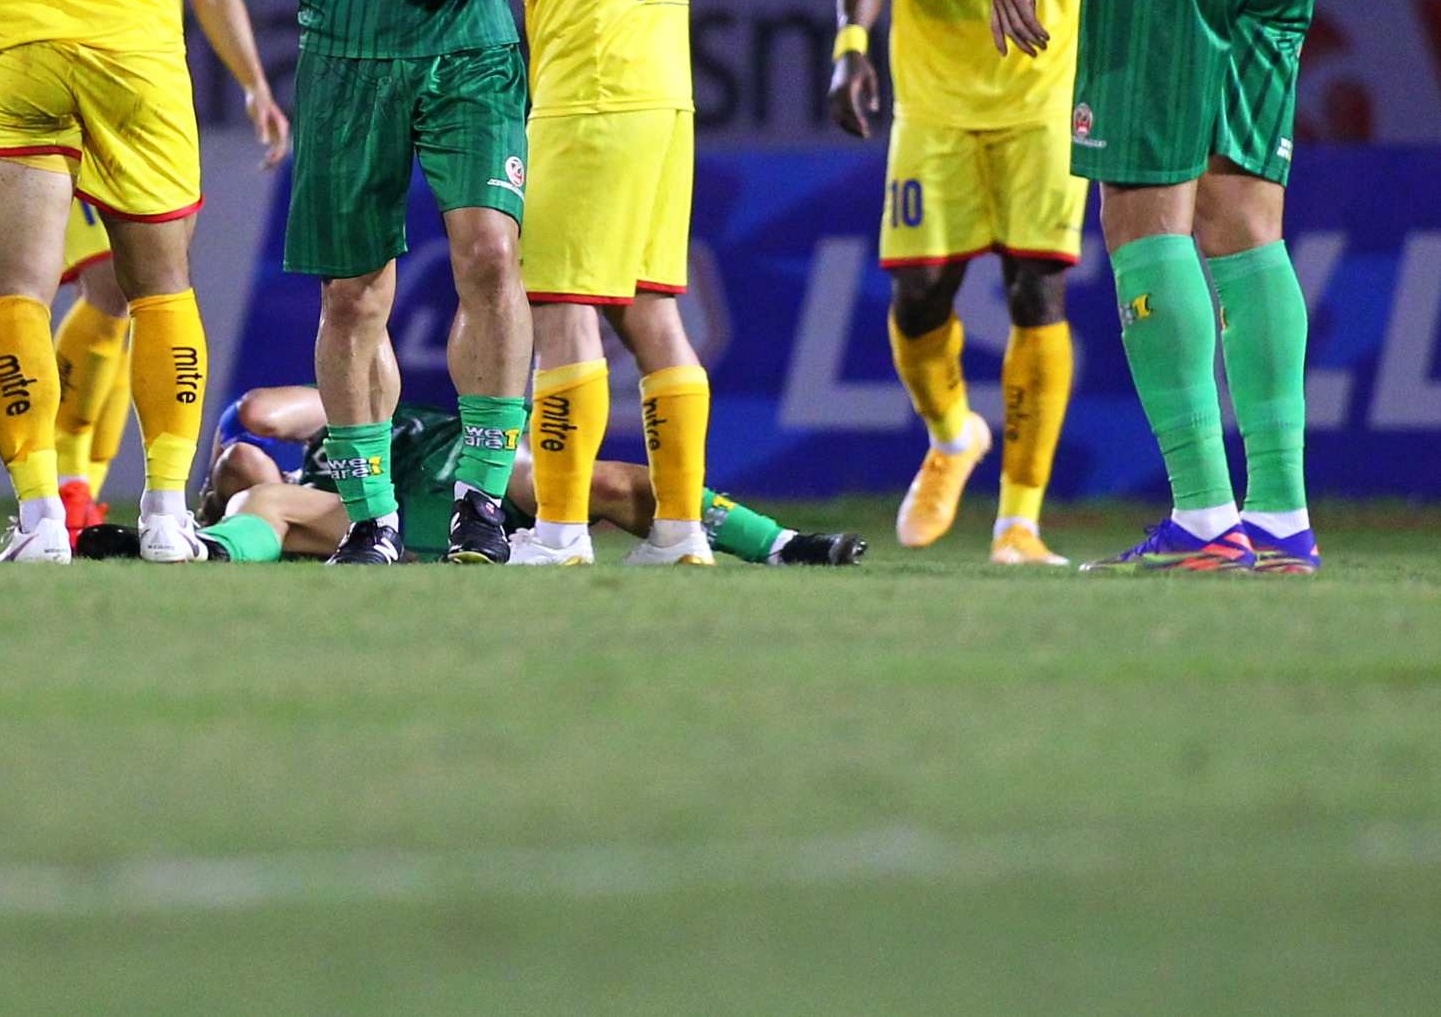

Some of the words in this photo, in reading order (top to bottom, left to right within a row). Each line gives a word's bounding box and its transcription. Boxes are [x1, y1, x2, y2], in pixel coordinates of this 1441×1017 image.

[891, 178, 923, 230] 10
[172, 347, 203, 404] mitre
[541, 394, 578, 452] mitre
[465, 425, 503, 437] we
[465, 435, 503, 449] are
[328, 457, 368, 469] we
[331, 466, 369, 479] are
